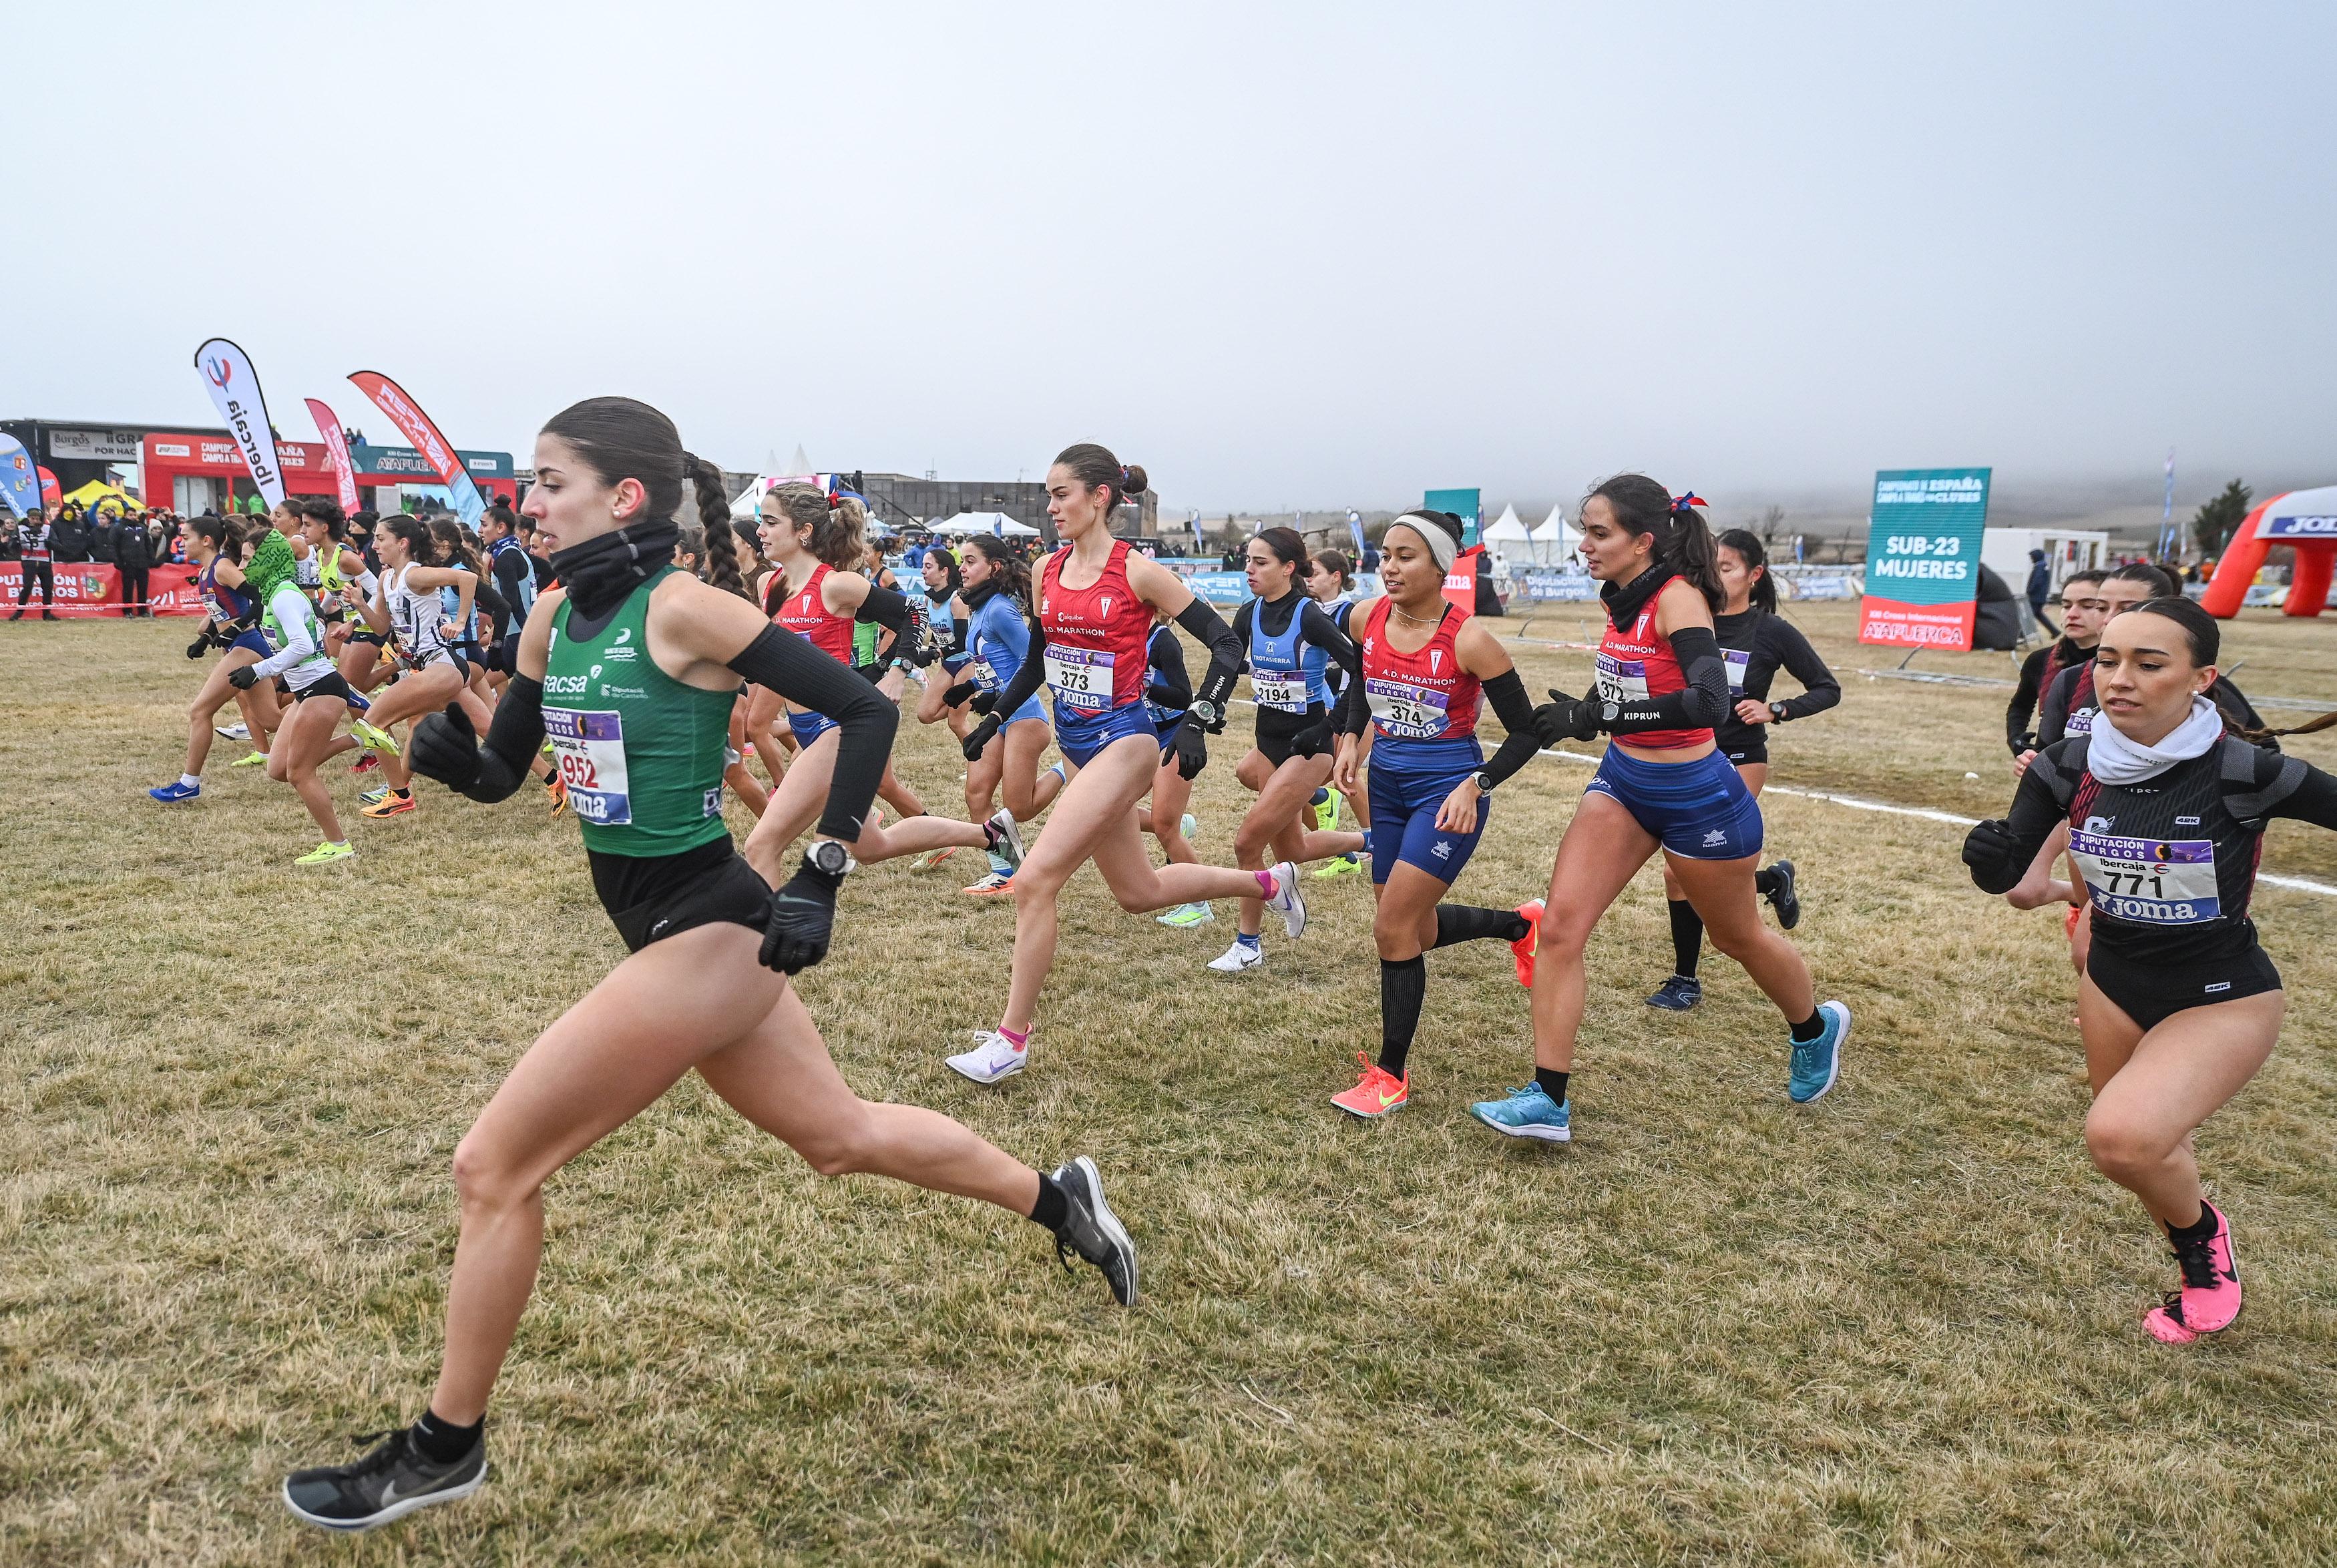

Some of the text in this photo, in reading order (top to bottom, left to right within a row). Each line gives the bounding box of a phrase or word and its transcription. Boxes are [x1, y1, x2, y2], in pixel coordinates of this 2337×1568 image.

[55, 433, 90, 447] Burgos
[95, 447, 114, 455] POR
[201, 443, 234, 453] CAMPEON
[202, 453, 224, 463] CAMPO
[1928, 477, 1982, 491] ESPAÑA
[1886, 535, 1960, 556] SUB-23
[1874, 558, 1968, 580] MUJERES
[1525, 575, 1586, 588] Diputación
[8, 587, 78, 599] BROS
[1530, 587, 1587, 598] de Burgos
[1882, 611, 1906, 620] Cross
[1907, 612, 1962, 624] Internacional
[1056, 627, 1106, 637] MARATHON
[1863, 621, 1964, 645] ATAPUERCA
[1050, 645, 1081, 657] DIPUTACIÓN
[1605, 641, 1656, 654] A.D. MARATHON
[1050, 651, 1080, 663] BURGOS
[1253, 655, 1291, 664] TROTASIERRA
[1059, 661, 1080, 672] Ibercaja
[1061, 670, 1089, 691] 373
[1382, 668, 1456, 686] A.D. MARATHON
[1599, 670, 1615, 682] Ibercaja
[1373, 681, 1412, 693] DIPUTACIÓN
[1373, 688, 1411, 699] BURGOS
[1601, 680, 1625, 701] 372
[1259, 687, 1291, 702] 2194
[1387, 697, 1412, 708] Ibercaja
[1392, 705, 1423, 726] 374
[1624, 712, 1661, 720] KIPRUN
[570, 790, 608, 819] oma
[1702, 839, 1727, 848] luanvi
[2079, 834, 2145, 851] DIPUTACIÓN
[1430, 848, 1450, 861] luanvi
[2079, 844, 2145, 860] BURGOS
[2099, 858, 2146, 872] Ibercaja
[2103, 871, 2163, 898] 771
